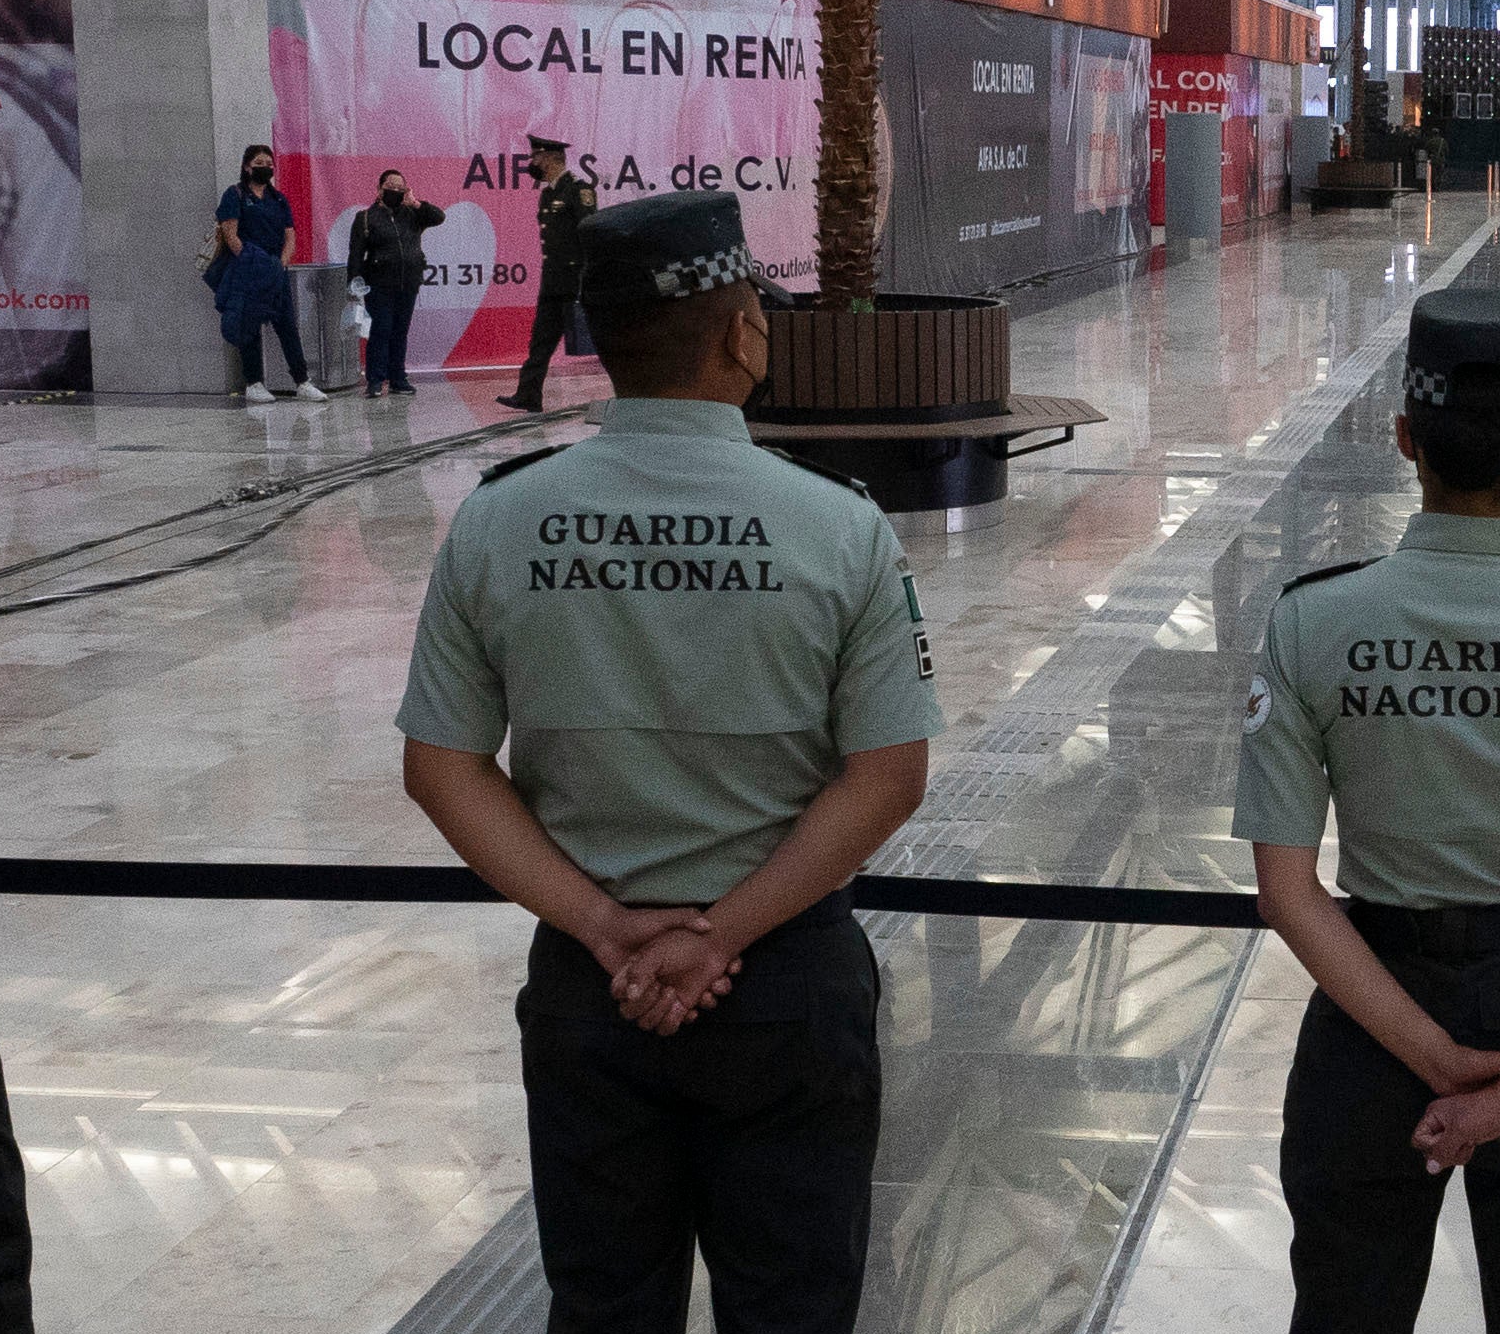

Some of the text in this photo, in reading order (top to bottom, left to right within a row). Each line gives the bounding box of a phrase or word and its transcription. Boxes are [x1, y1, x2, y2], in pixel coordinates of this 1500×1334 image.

[417, 21, 807, 81] LOCAL EN RENTA
[462, 153, 796, 192] AIF S.A. de C.V.
[422, 264, 448, 286] 21
[457, 264, 483, 286] 31
[492, 263, 528, 285] 80
[539, 513, 771, 547] GUARDIA
[528, 558, 783, 593] NACIONAL
